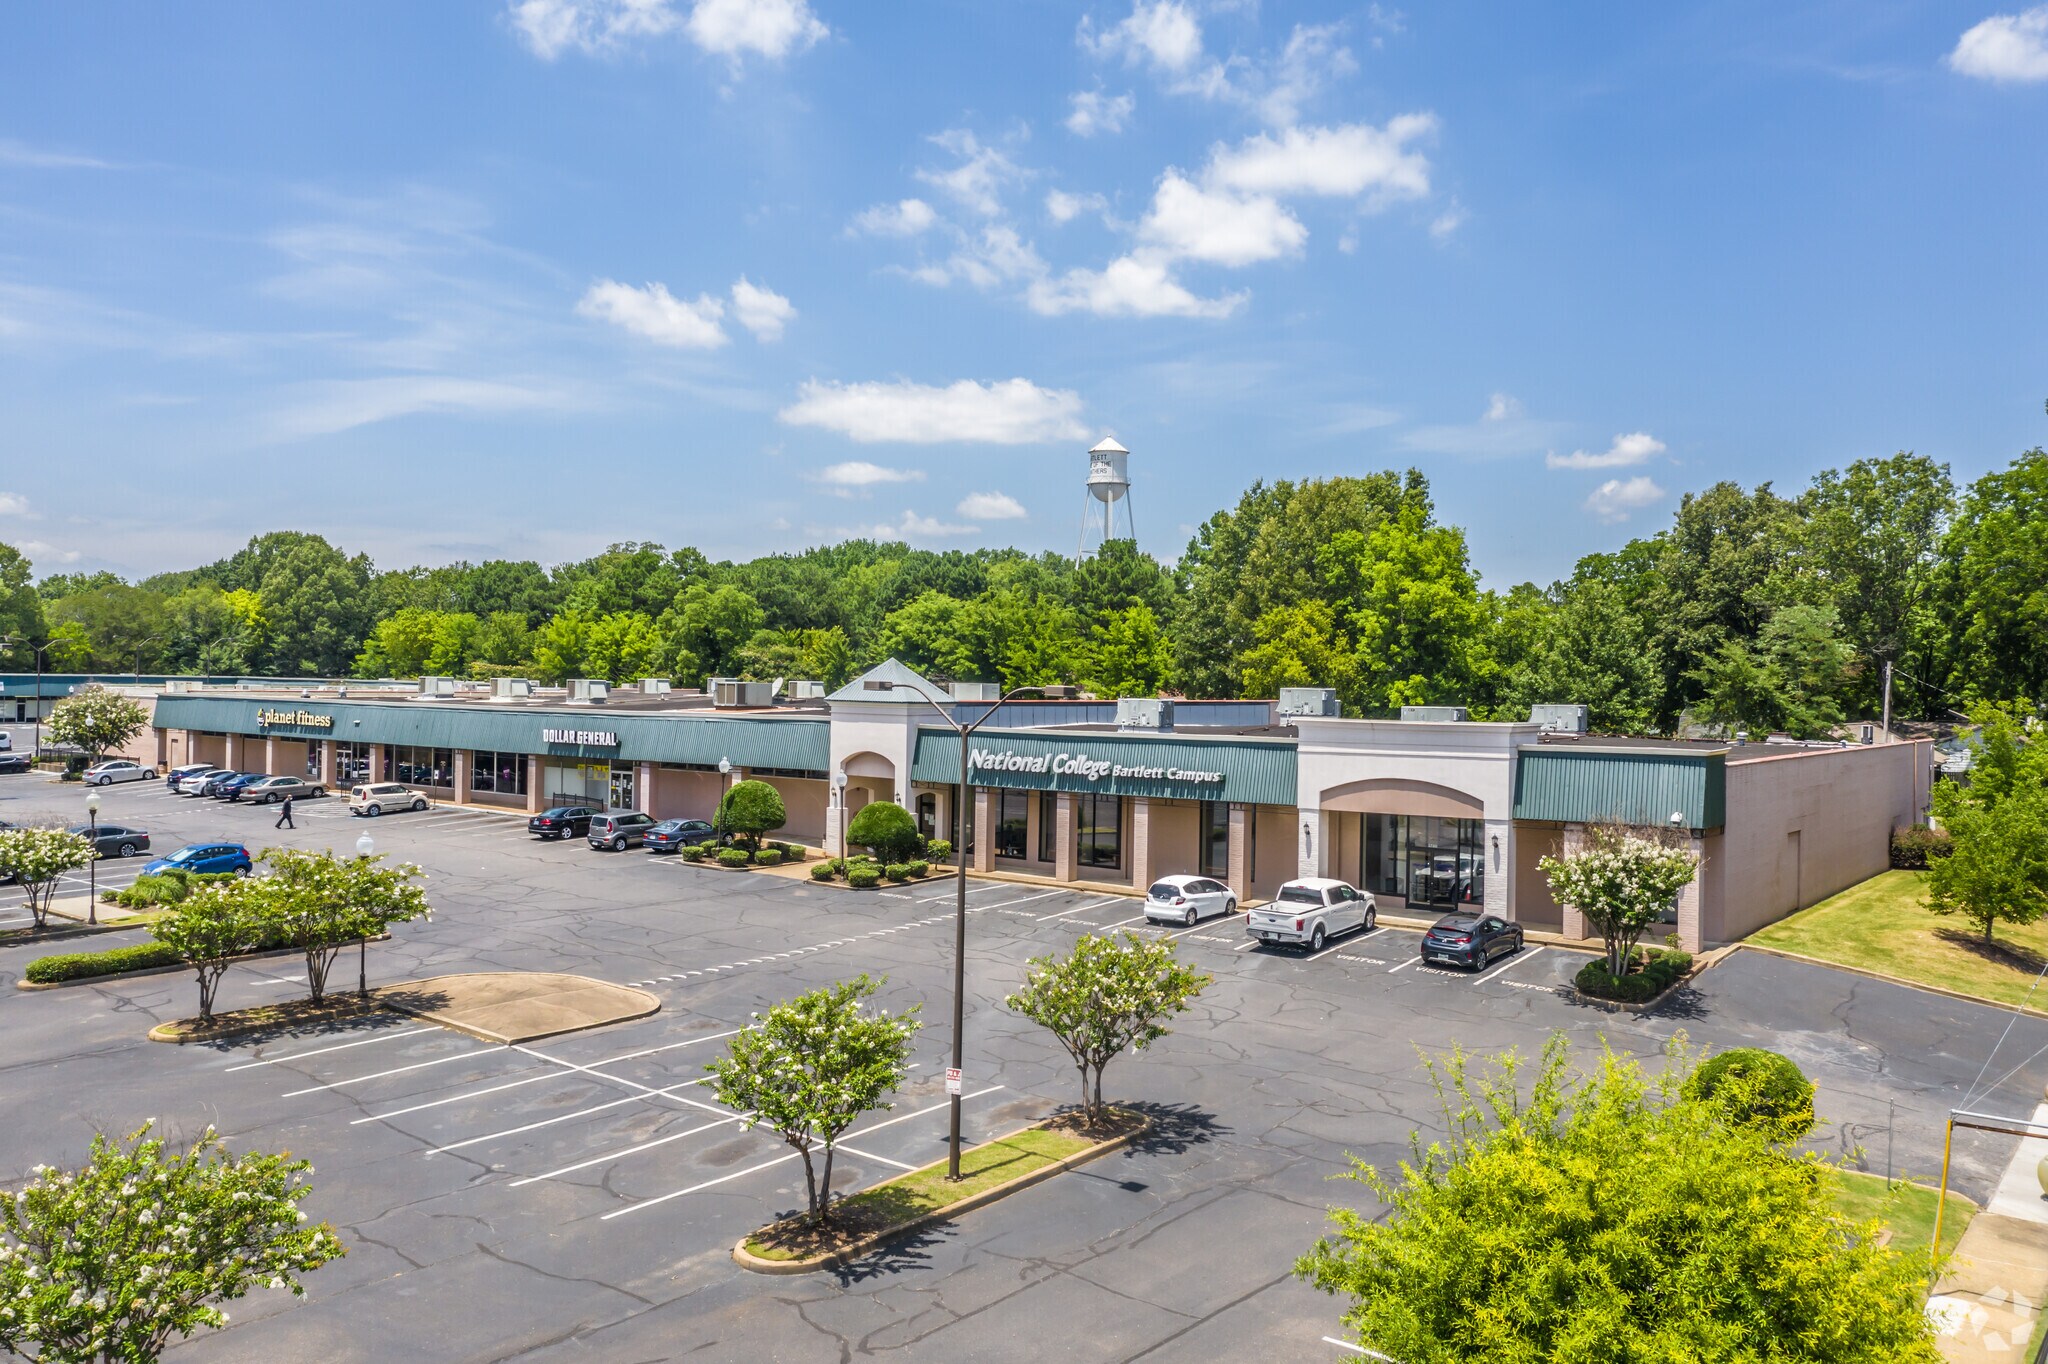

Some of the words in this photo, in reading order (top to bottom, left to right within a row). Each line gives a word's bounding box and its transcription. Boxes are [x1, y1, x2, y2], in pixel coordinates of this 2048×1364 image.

[264, 709, 296, 727] planet
[297, 710, 331, 727] fitness
[543, 729, 575, 744] DOLLAR
[576, 730, 617, 746] GENERAL
[967, 748, 1053, 773] National
[1053, 753, 1111, 781] College
[1112, 764, 1163, 778] Bartlett
[1167, 767, 1221, 784] Campus
[1336, 954, 1387, 966] VISITOR
[1415, 966, 1468, 979] VISITOR
[1501, 979, 1556, 993] VISITOR
